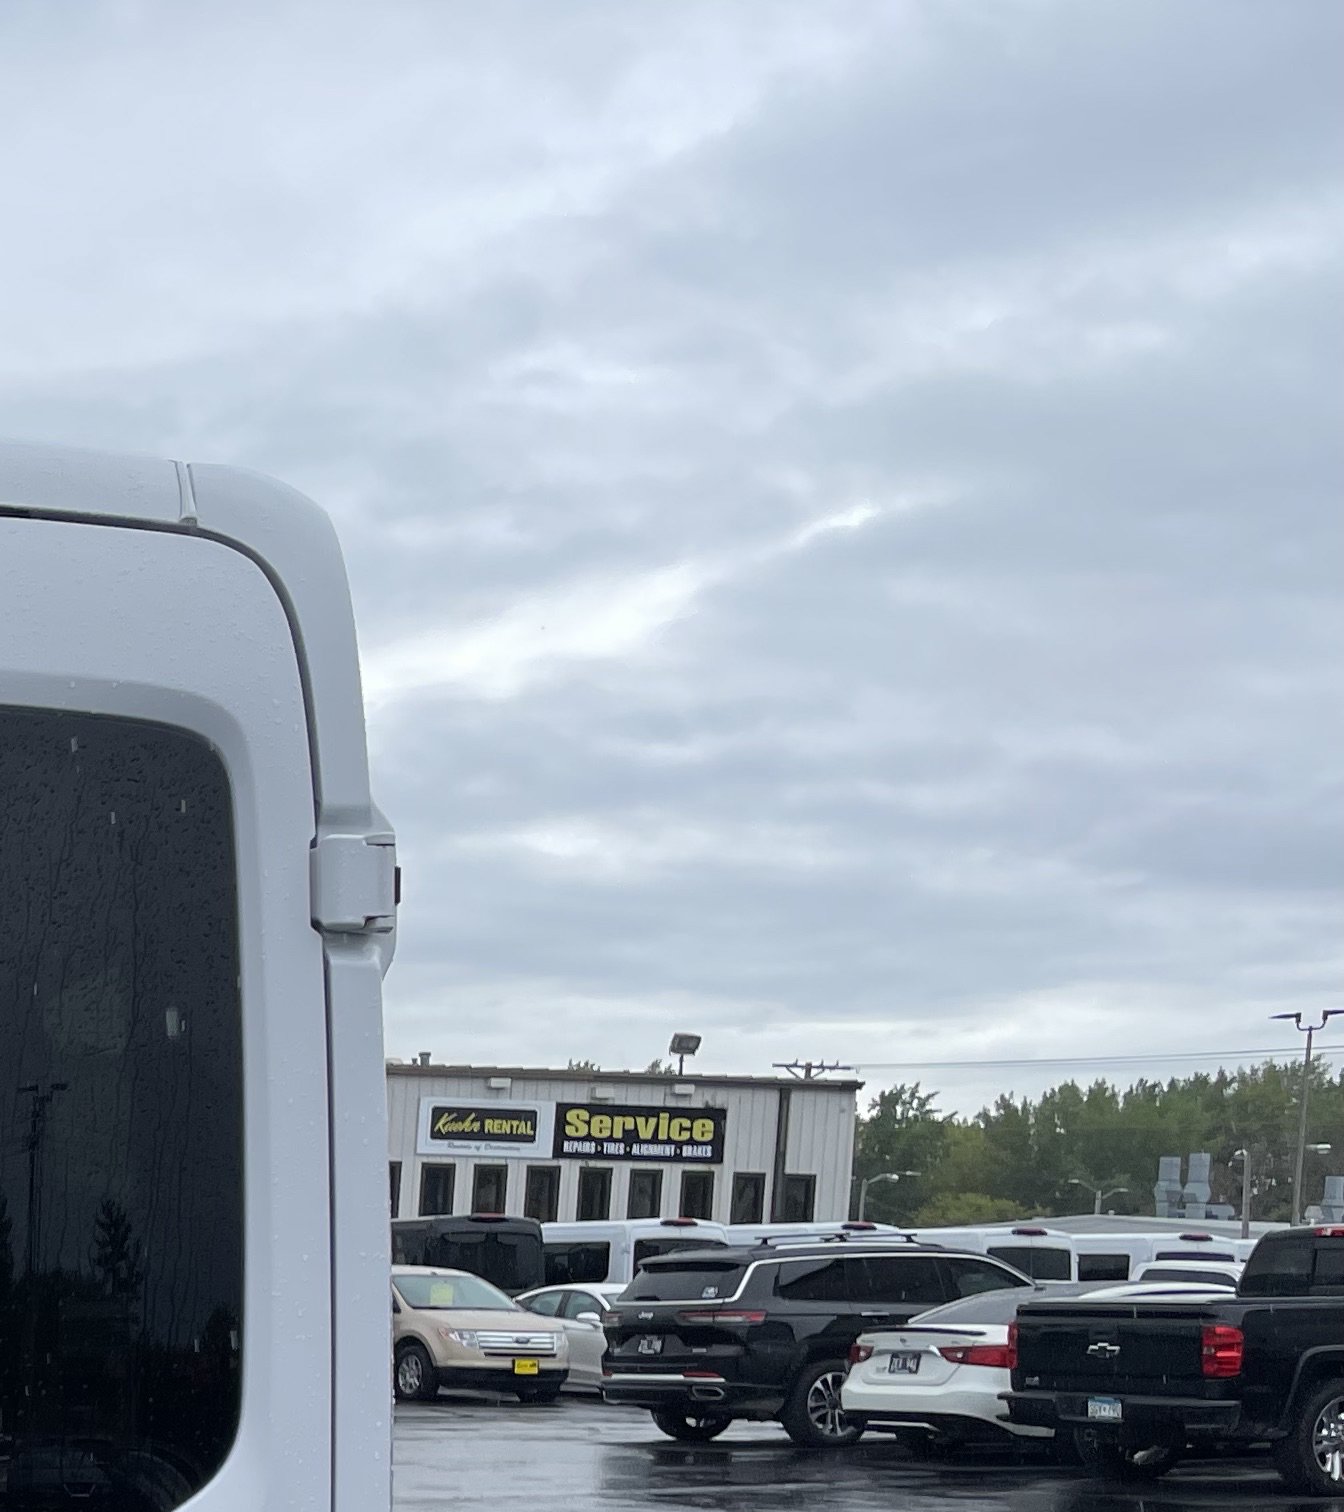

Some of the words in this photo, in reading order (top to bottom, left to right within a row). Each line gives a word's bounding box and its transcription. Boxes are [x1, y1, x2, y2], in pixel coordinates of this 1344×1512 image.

[484, 1118, 534, 1136] RENTAL
[564, 1108, 715, 1142] Service
[563, 1140, 596, 1154] REPAIRS
[603, 1142, 625, 1155] TIRES
[631, 1142, 676, 1157] ALIGNMENT
[682, 1144, 712, 1158] BRAKES
